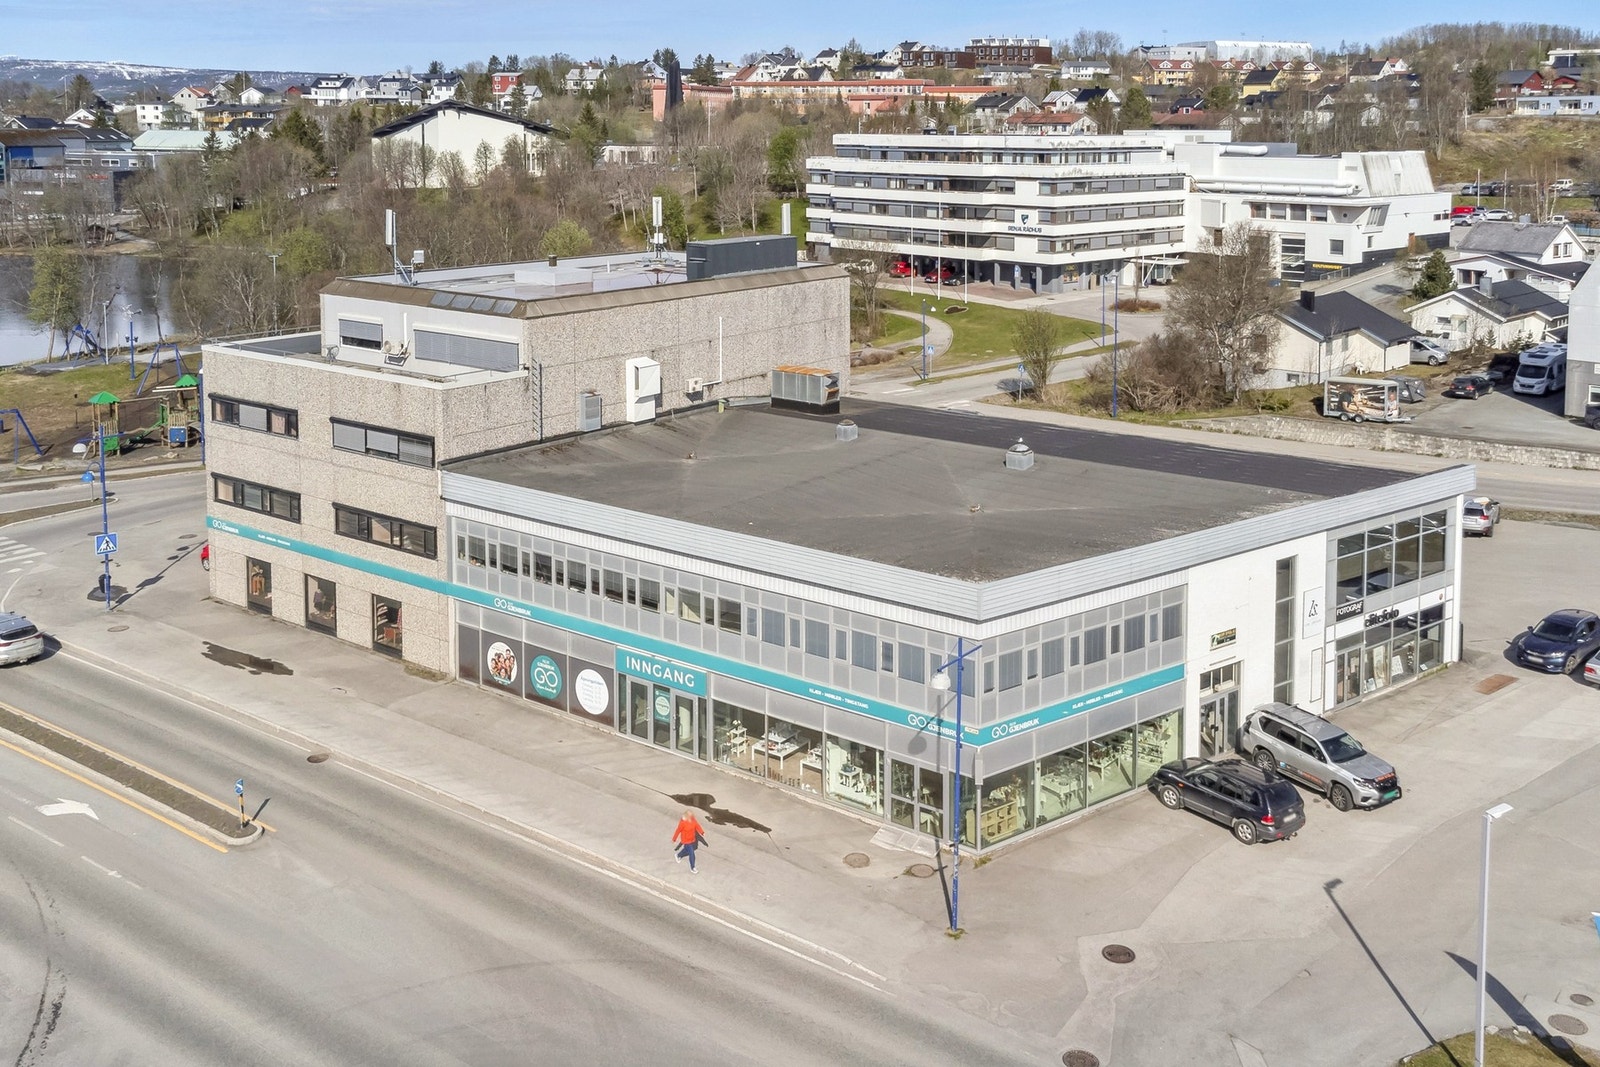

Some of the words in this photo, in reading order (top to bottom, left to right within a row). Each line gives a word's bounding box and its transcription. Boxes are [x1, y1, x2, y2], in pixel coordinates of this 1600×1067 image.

[494, 597, 507, 609] GO
[1336, 601, 1363, 616] FOTOGRAF
[534, 667, 558, 687] GO
[626, 655, 695, 687] INNGANG
[907, 713, 927, 728] GO
[992, 724, 1008, 738] GO
[1008, 717, 1040, 733] GJENBRUK
